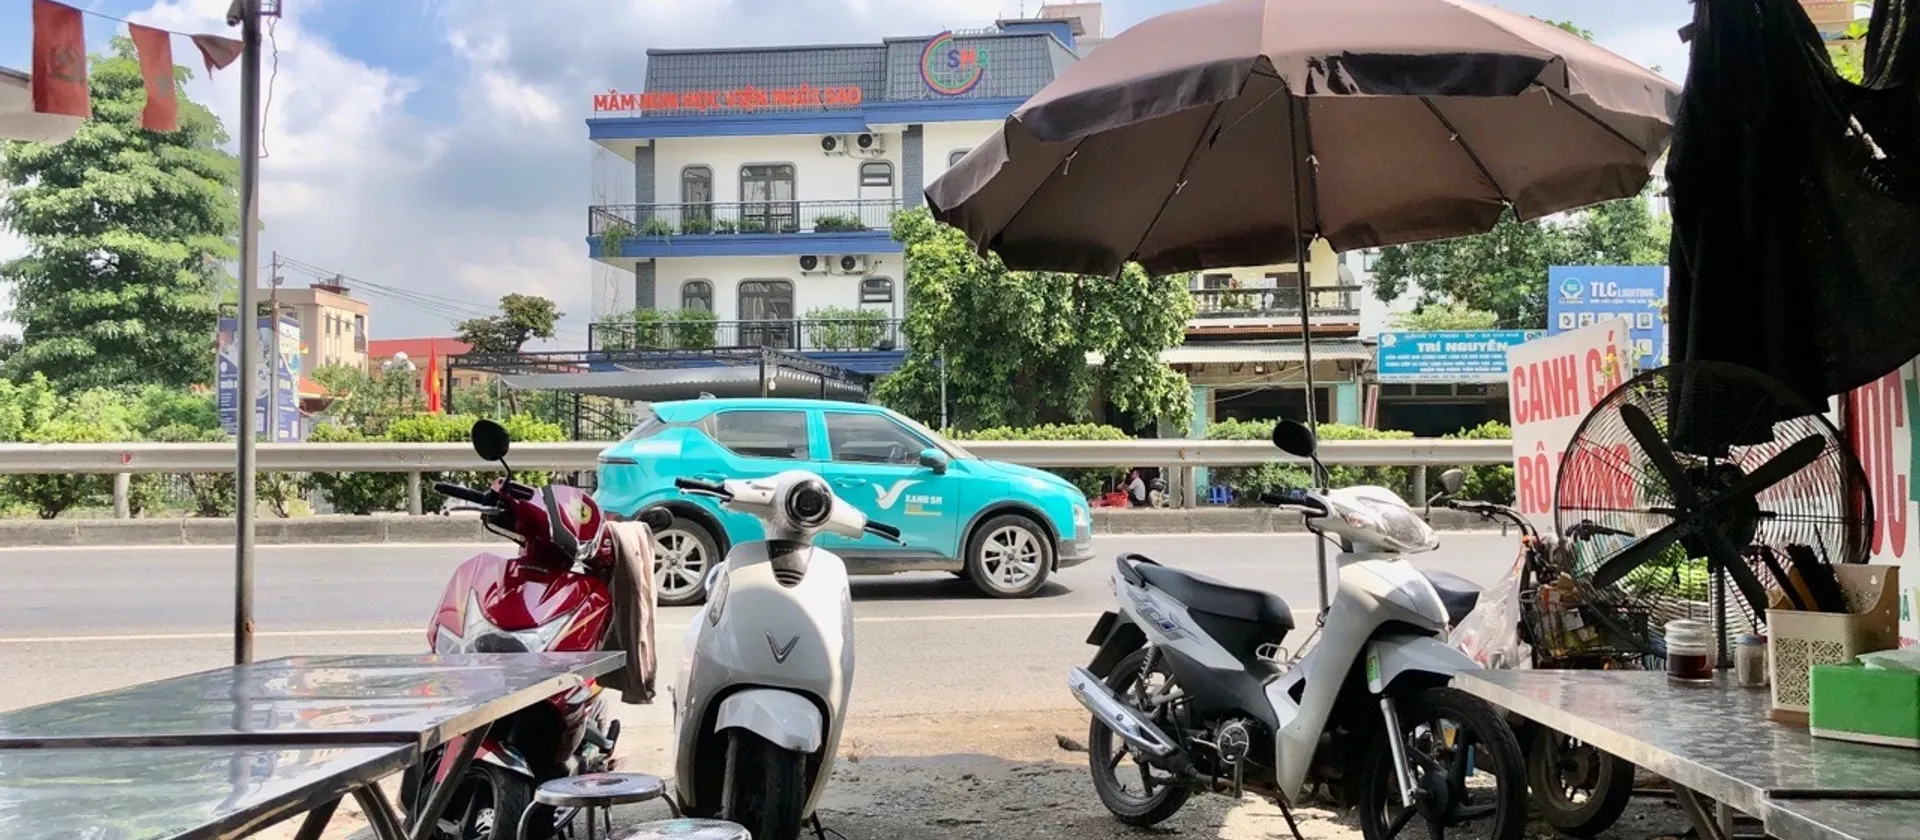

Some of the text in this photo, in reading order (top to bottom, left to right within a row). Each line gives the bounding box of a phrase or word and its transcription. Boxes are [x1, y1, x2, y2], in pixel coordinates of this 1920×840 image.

[593, 88, 635, 111] MẦM
[1590, 281, 1617, 298] TLC
[1416, 340, 1441, 353] TRÍ
[1512, 329, 1623, 425] CANH CÁ
[1518, 440, 1551, 515] RÔ
